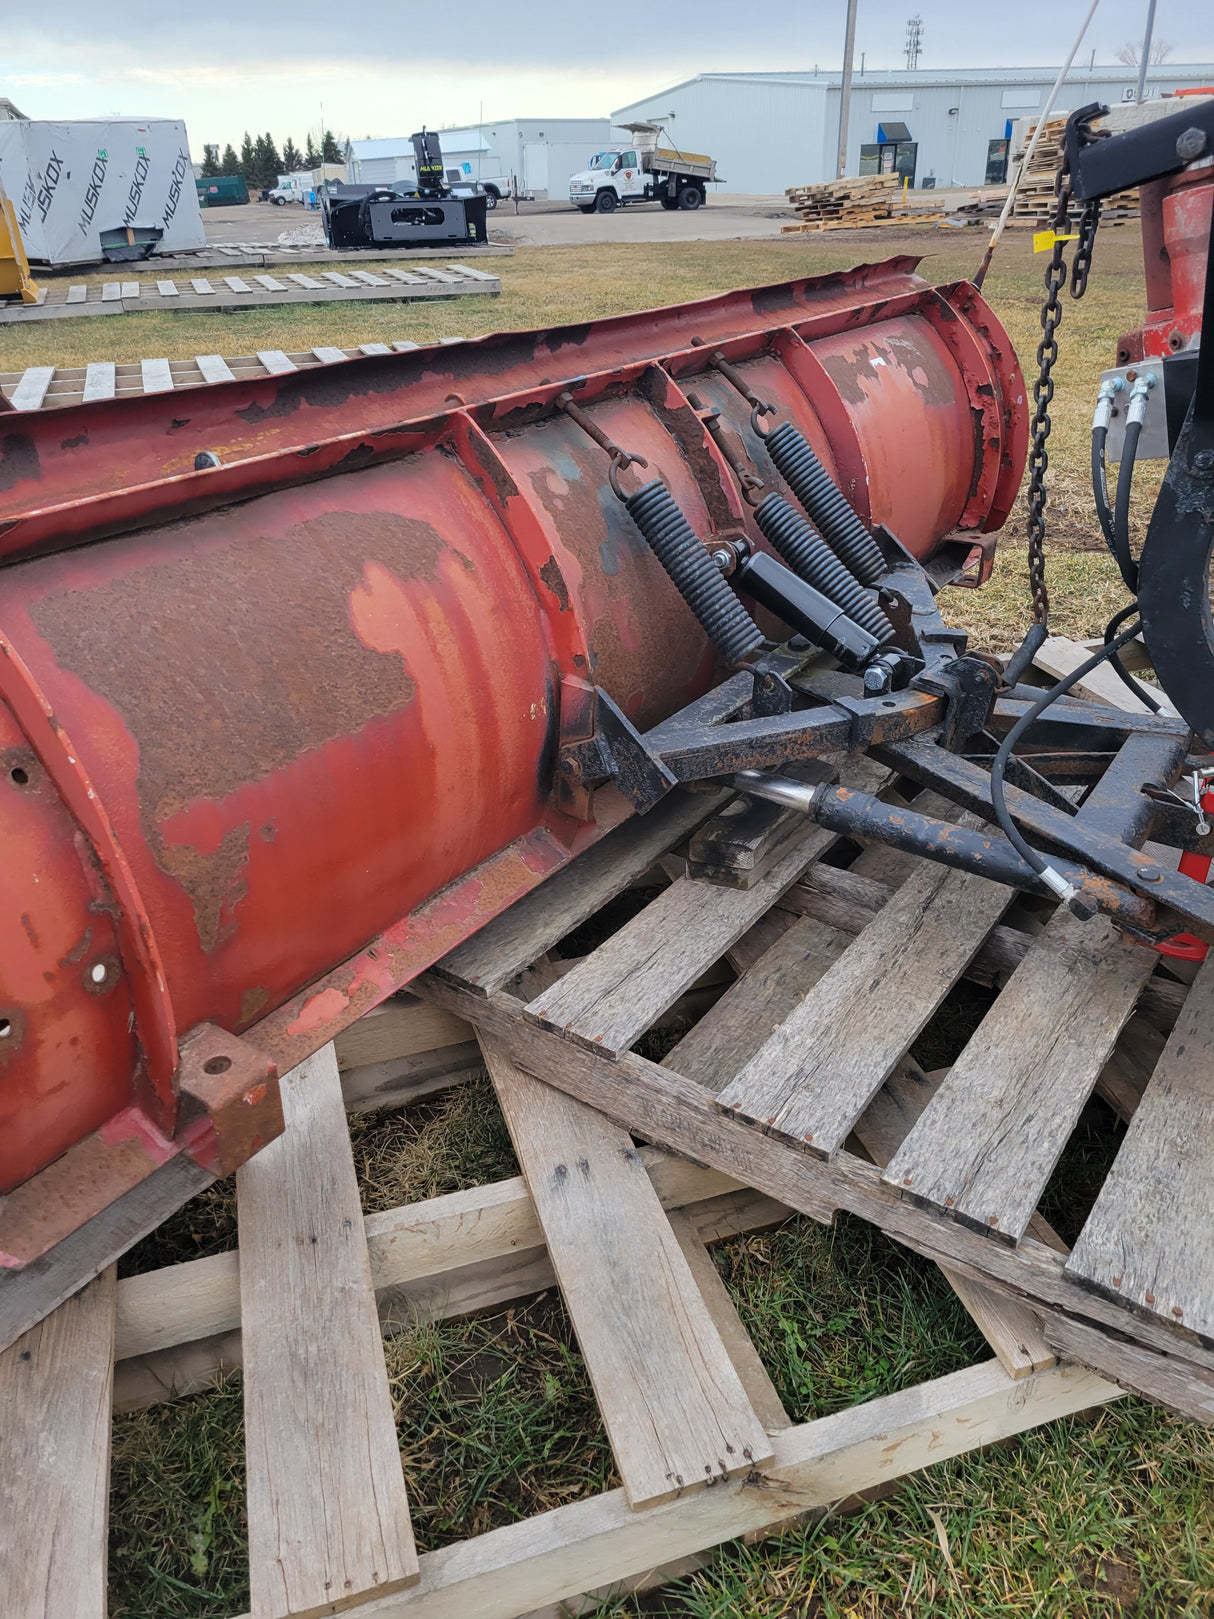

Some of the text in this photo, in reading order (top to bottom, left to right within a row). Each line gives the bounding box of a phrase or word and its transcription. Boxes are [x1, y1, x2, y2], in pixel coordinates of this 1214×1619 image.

[37, 149, 63, 224] USKOX
[77, 148, 108, 236] MUSKOX
[122, 152, 150, 228] MUSKOX
[162, 147, 189, 230] MUSKOX
